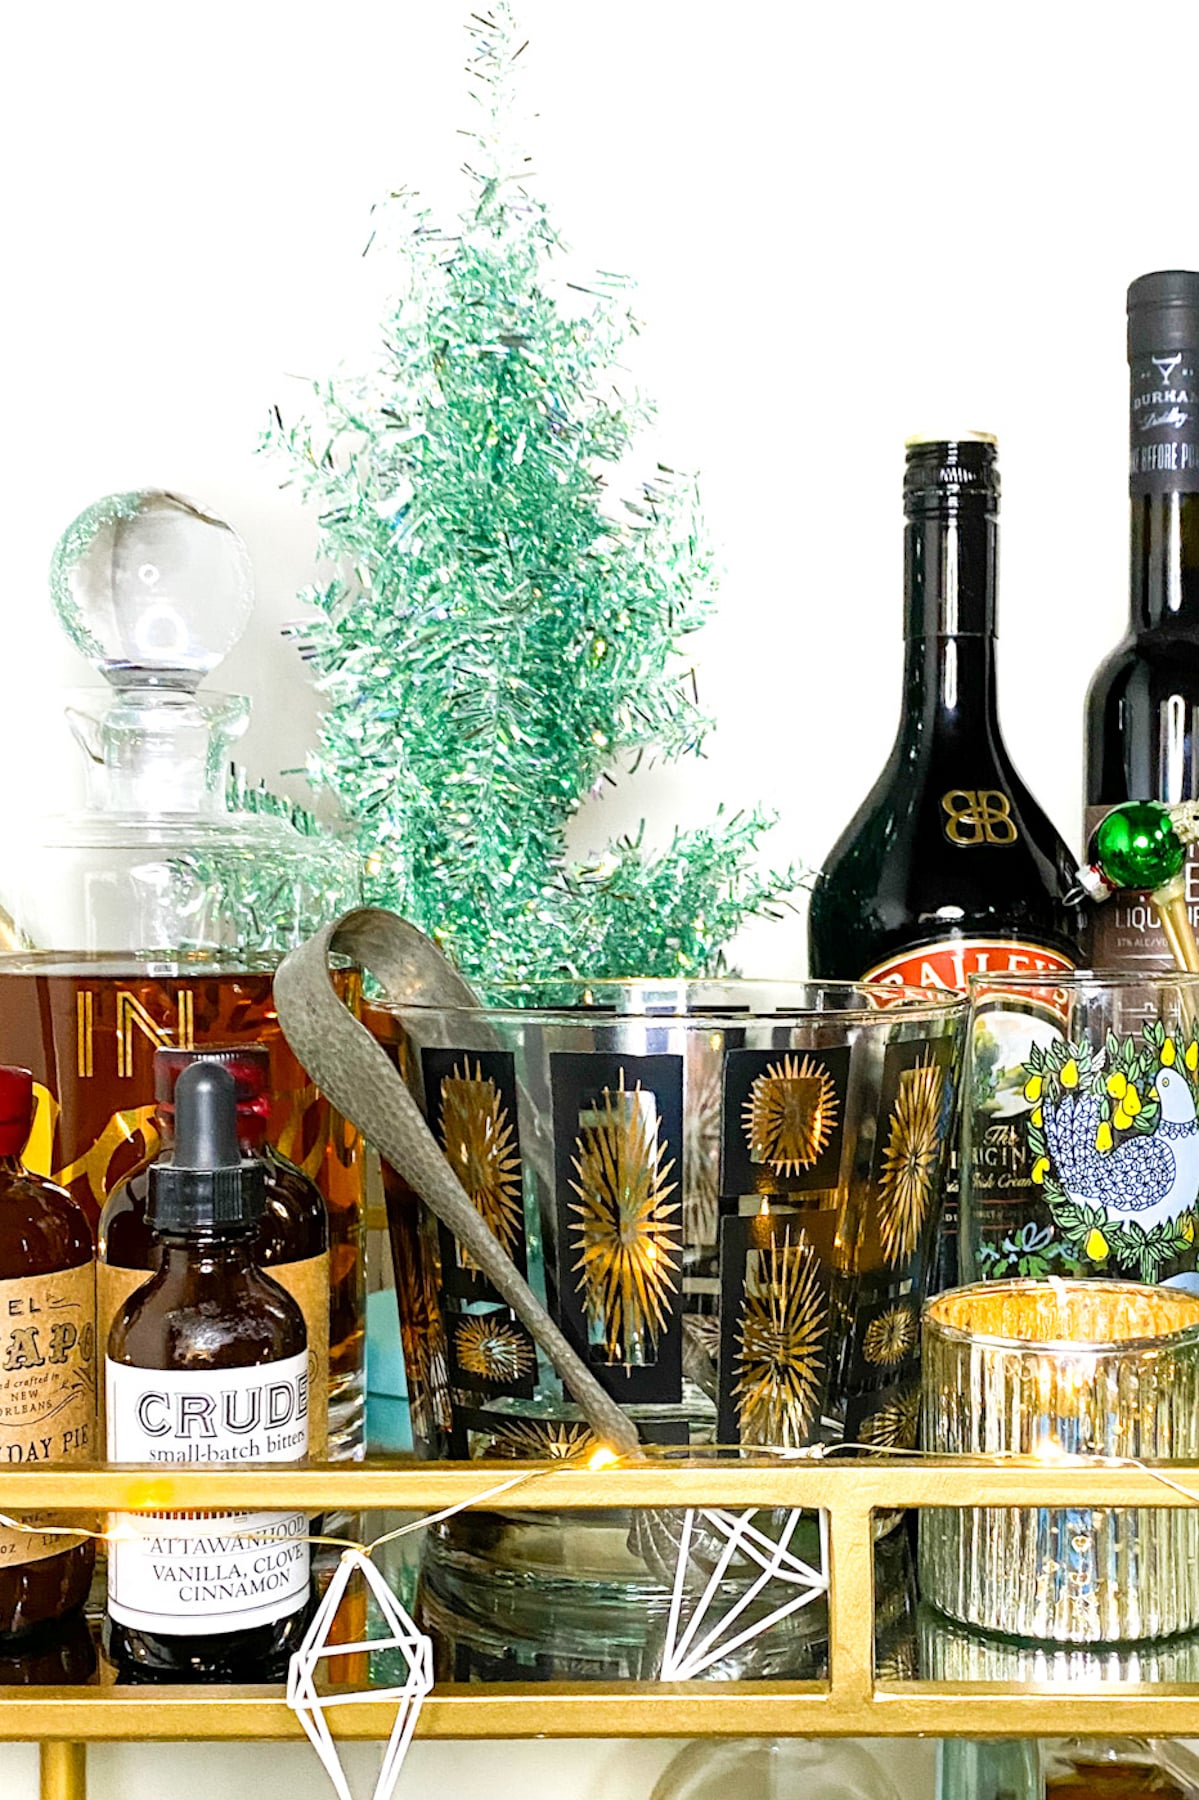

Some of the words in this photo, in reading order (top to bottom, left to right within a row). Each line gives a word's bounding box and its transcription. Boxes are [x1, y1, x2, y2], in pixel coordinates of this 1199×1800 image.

[0, 1322, 93, 1371] APO
[13, 1373, 49, 1388] crafted
[11, 1389, 38, 1402] NEW
[135, 1370, 308, 1438] CRUDE
[266, 1429, 305, 1453] bitters
[152, 1564, 247, 1583] VANILLA,
[179, 1568, 291, 1602] CINNAMON
